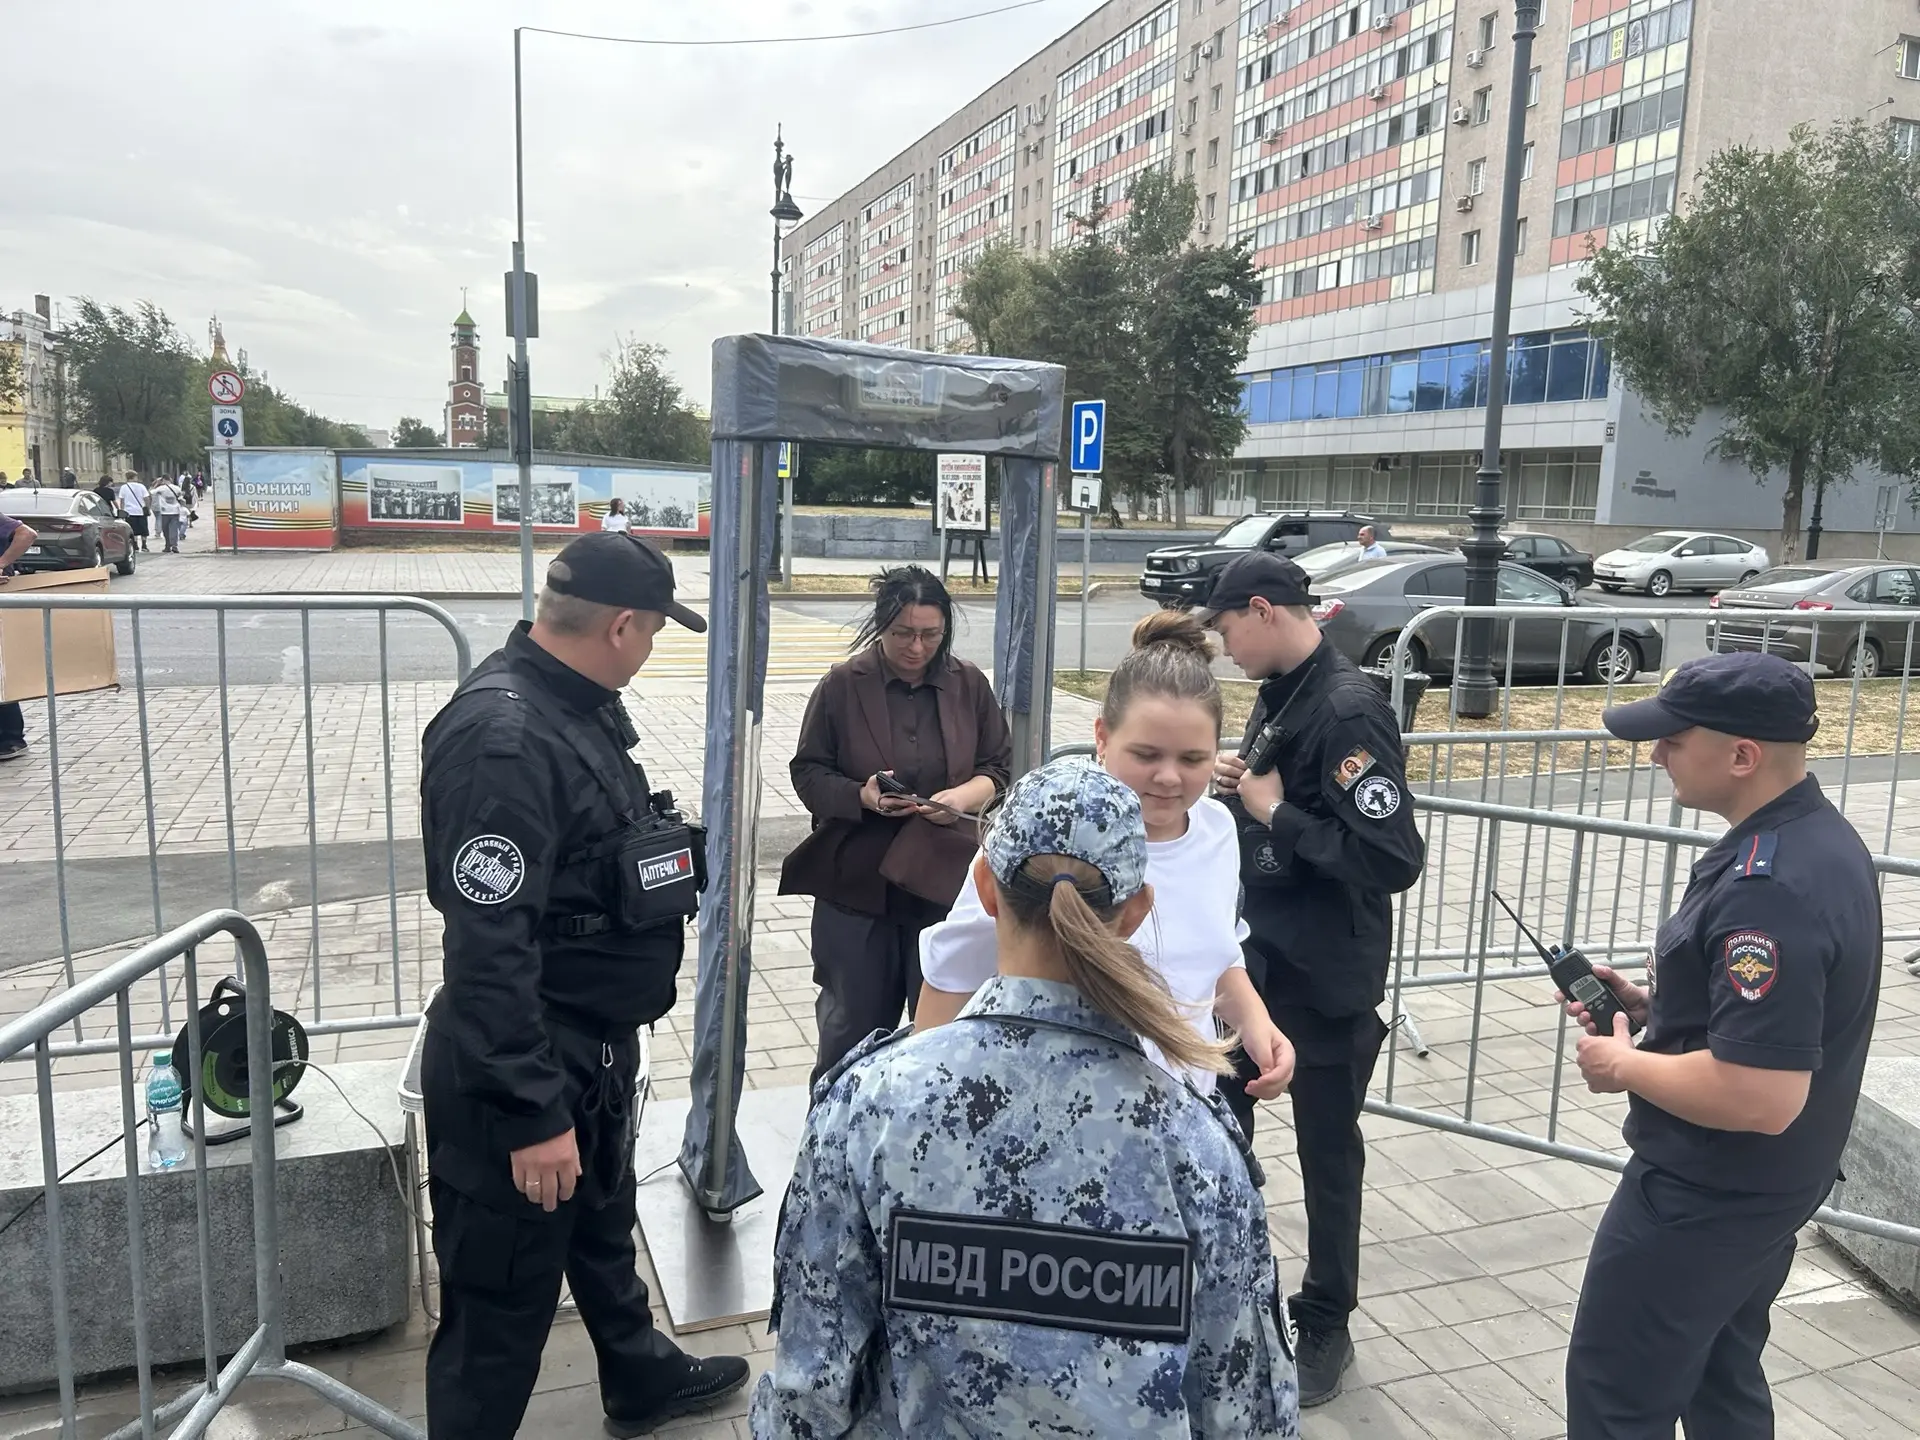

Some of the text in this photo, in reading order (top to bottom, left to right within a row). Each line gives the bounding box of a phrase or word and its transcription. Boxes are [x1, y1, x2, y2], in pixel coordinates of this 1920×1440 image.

[1079, 410, 1098, 464] P
[234, 482, 312, 496] ПОМНИМ!
[248, 500, 300, 513] ЧТИМ!
[643, 858, 680, 882] АПТЕЧКА
[457, 872, 500, 901] ОРЕНБУРГ
[1727, 934, 1773, 950] ПОЛИЦИЯ
[1732, 945, 1768, 960] РОССИЯ
[1741, 987, 1761, 1001] МВД
[898, 1239, 1181, 1308] МВД РОССИИ
